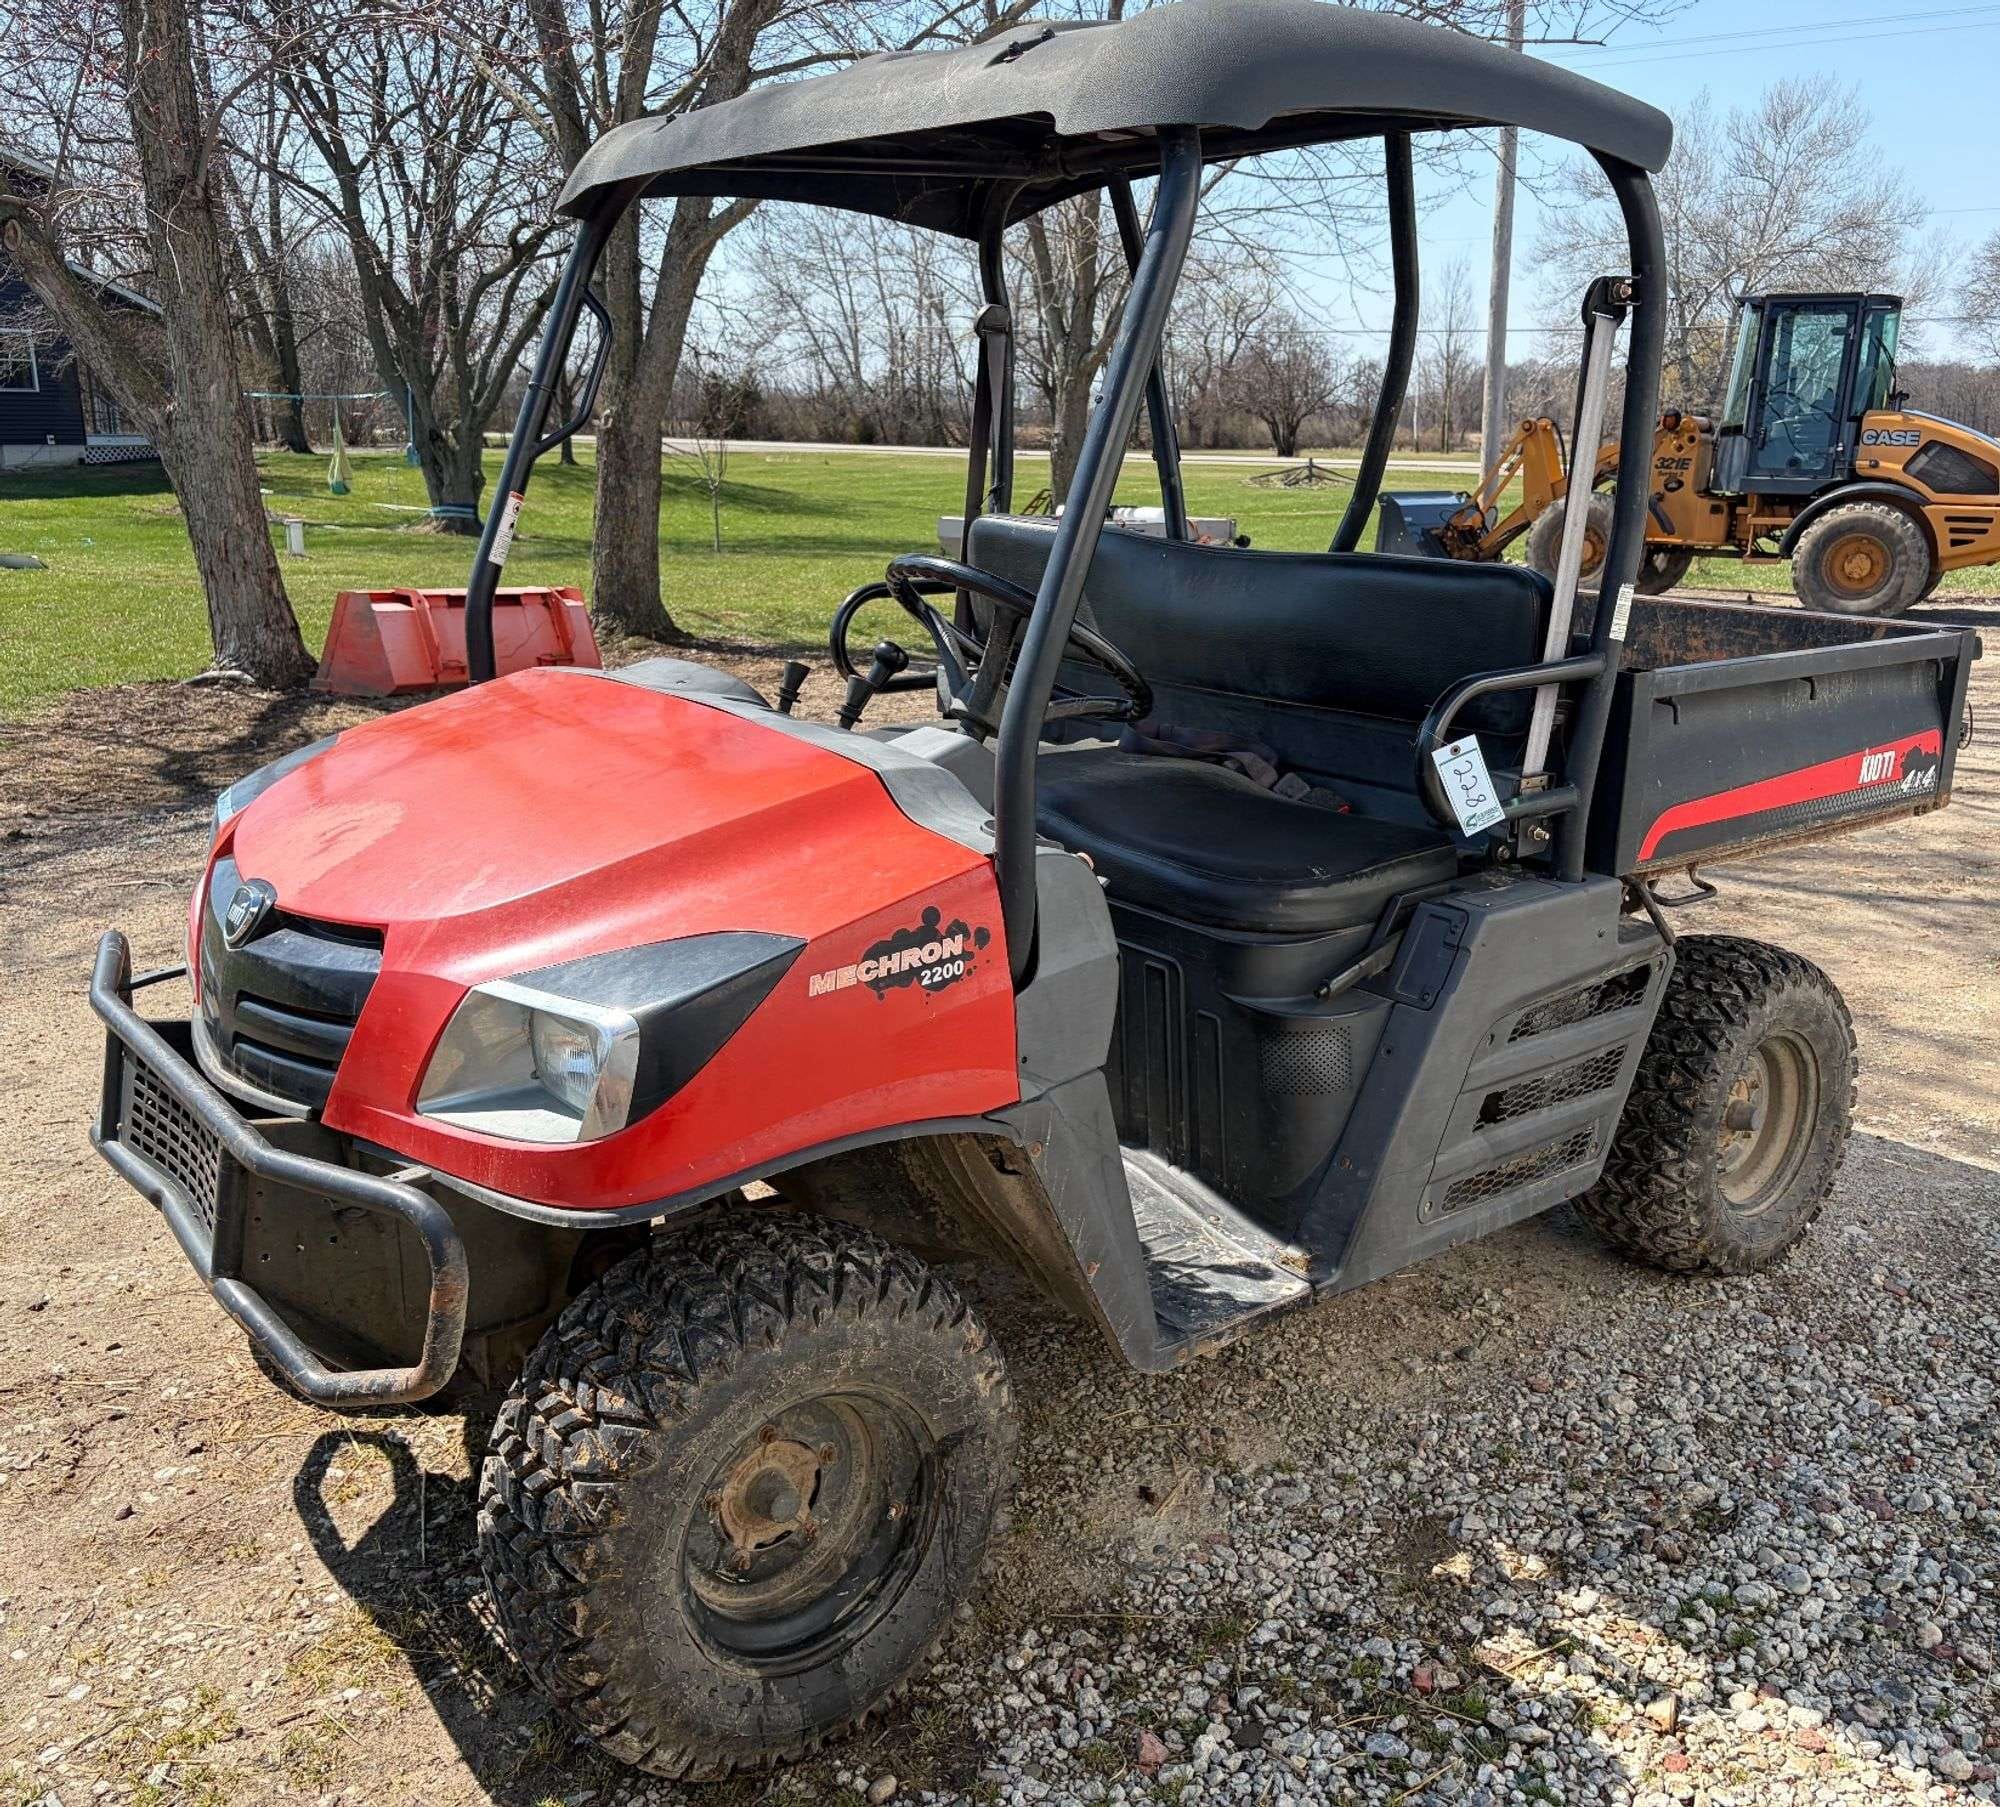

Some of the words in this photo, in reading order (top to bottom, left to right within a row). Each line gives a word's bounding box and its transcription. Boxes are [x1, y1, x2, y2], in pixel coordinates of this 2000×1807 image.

[1862, 429, 1920, 446] CASE
[1655, 457, 1692, 469] 321E
[1858, 750, 1895, 784] KIOTI
[1454, 760, 1486, 807] 228
[809, 934, 963, 997] MECHRON
[921, 960, 964, 986] 2200
